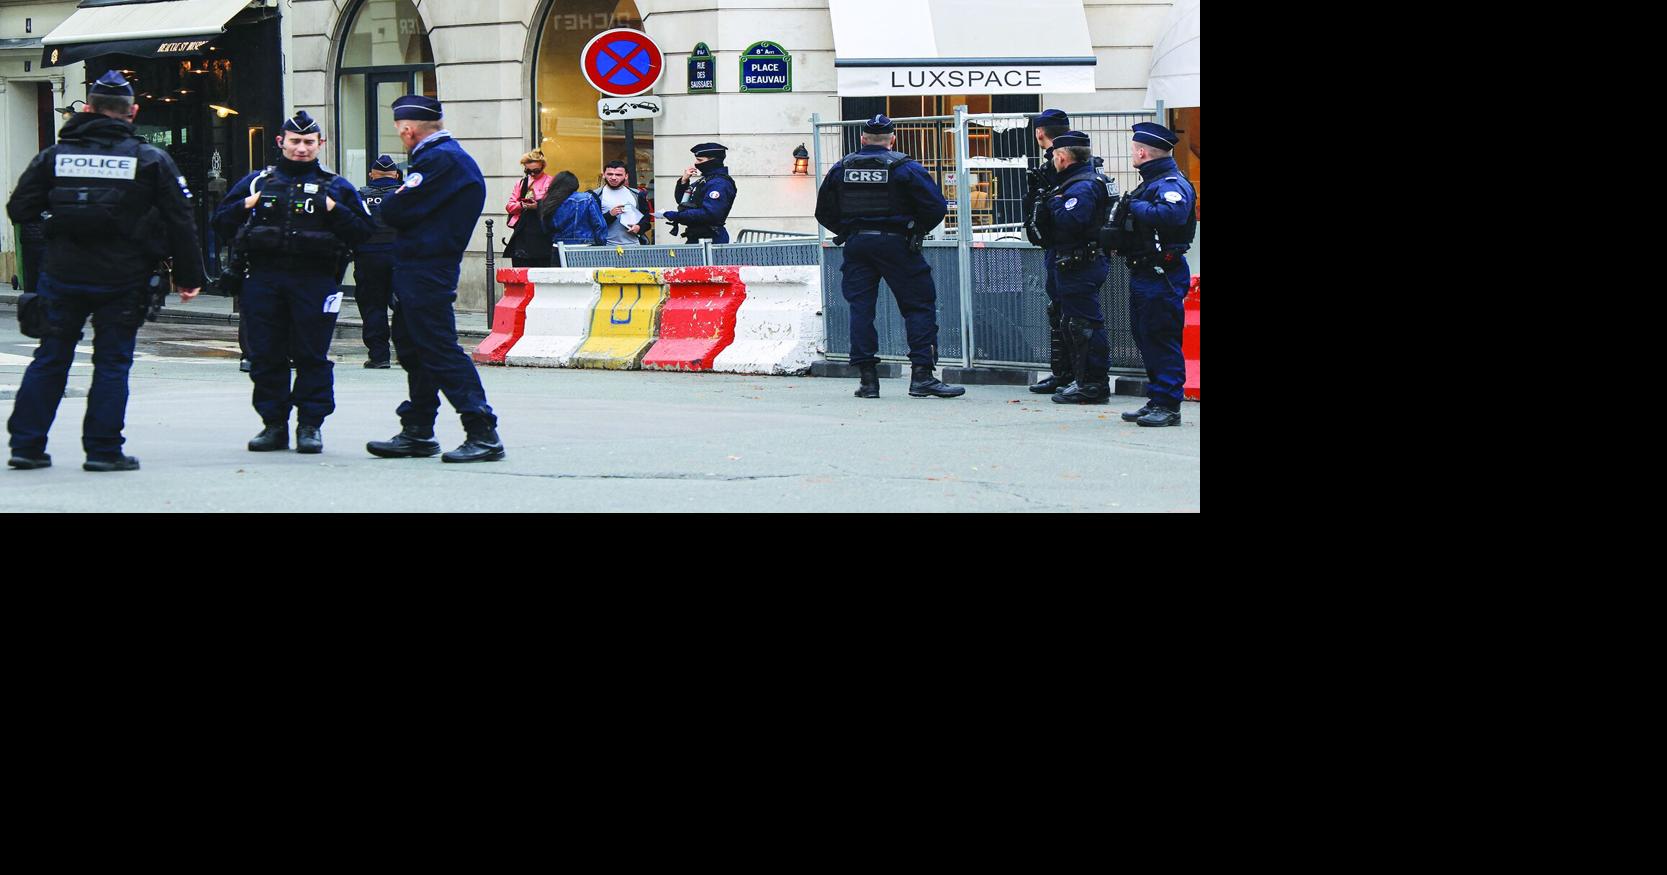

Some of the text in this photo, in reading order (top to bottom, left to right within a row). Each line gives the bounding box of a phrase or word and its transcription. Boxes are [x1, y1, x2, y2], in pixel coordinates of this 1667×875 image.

[696, 61, 706, 70] RUE
[751, 63, 779, 72] PLACE
[696, 71, 706, 79] DES
[745, 75, 786, 84] BEAUVAU
[891, 70, 1042, 88] LUXSPACE
[60, 157, 131, 169] POLICE
[848, 171, 882, 181] CRS
